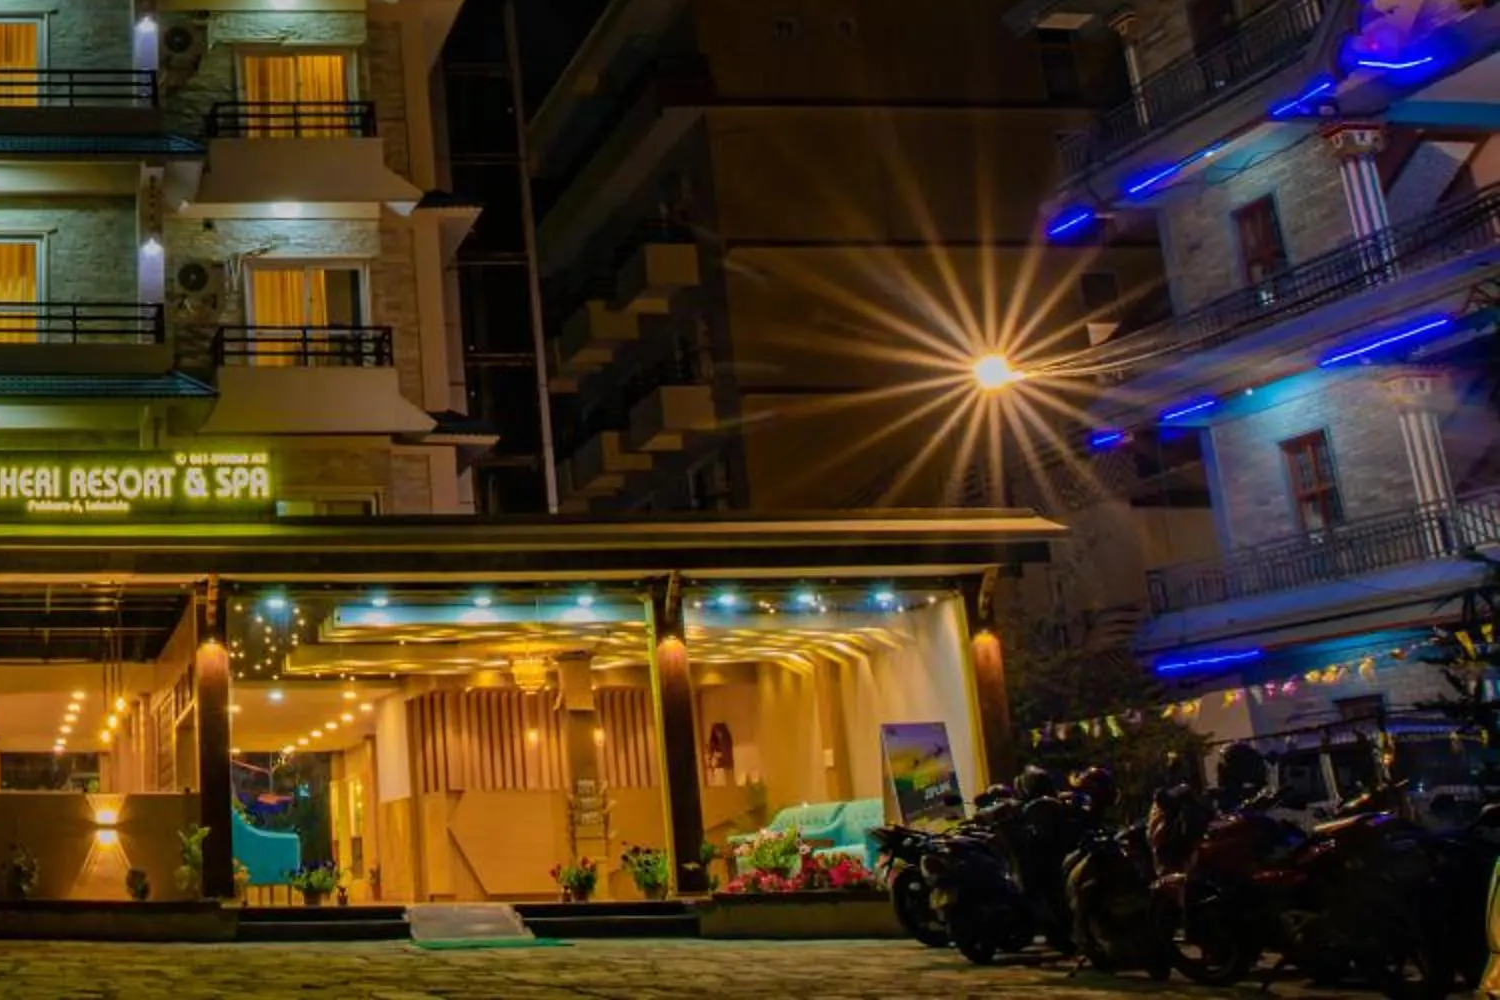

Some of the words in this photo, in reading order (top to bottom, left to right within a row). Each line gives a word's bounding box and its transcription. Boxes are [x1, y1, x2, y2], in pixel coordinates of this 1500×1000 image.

[69, 465, 176, 498] RESORT
[184, 466, 208, 497] &
[215, 466, 269, 497] SPA
